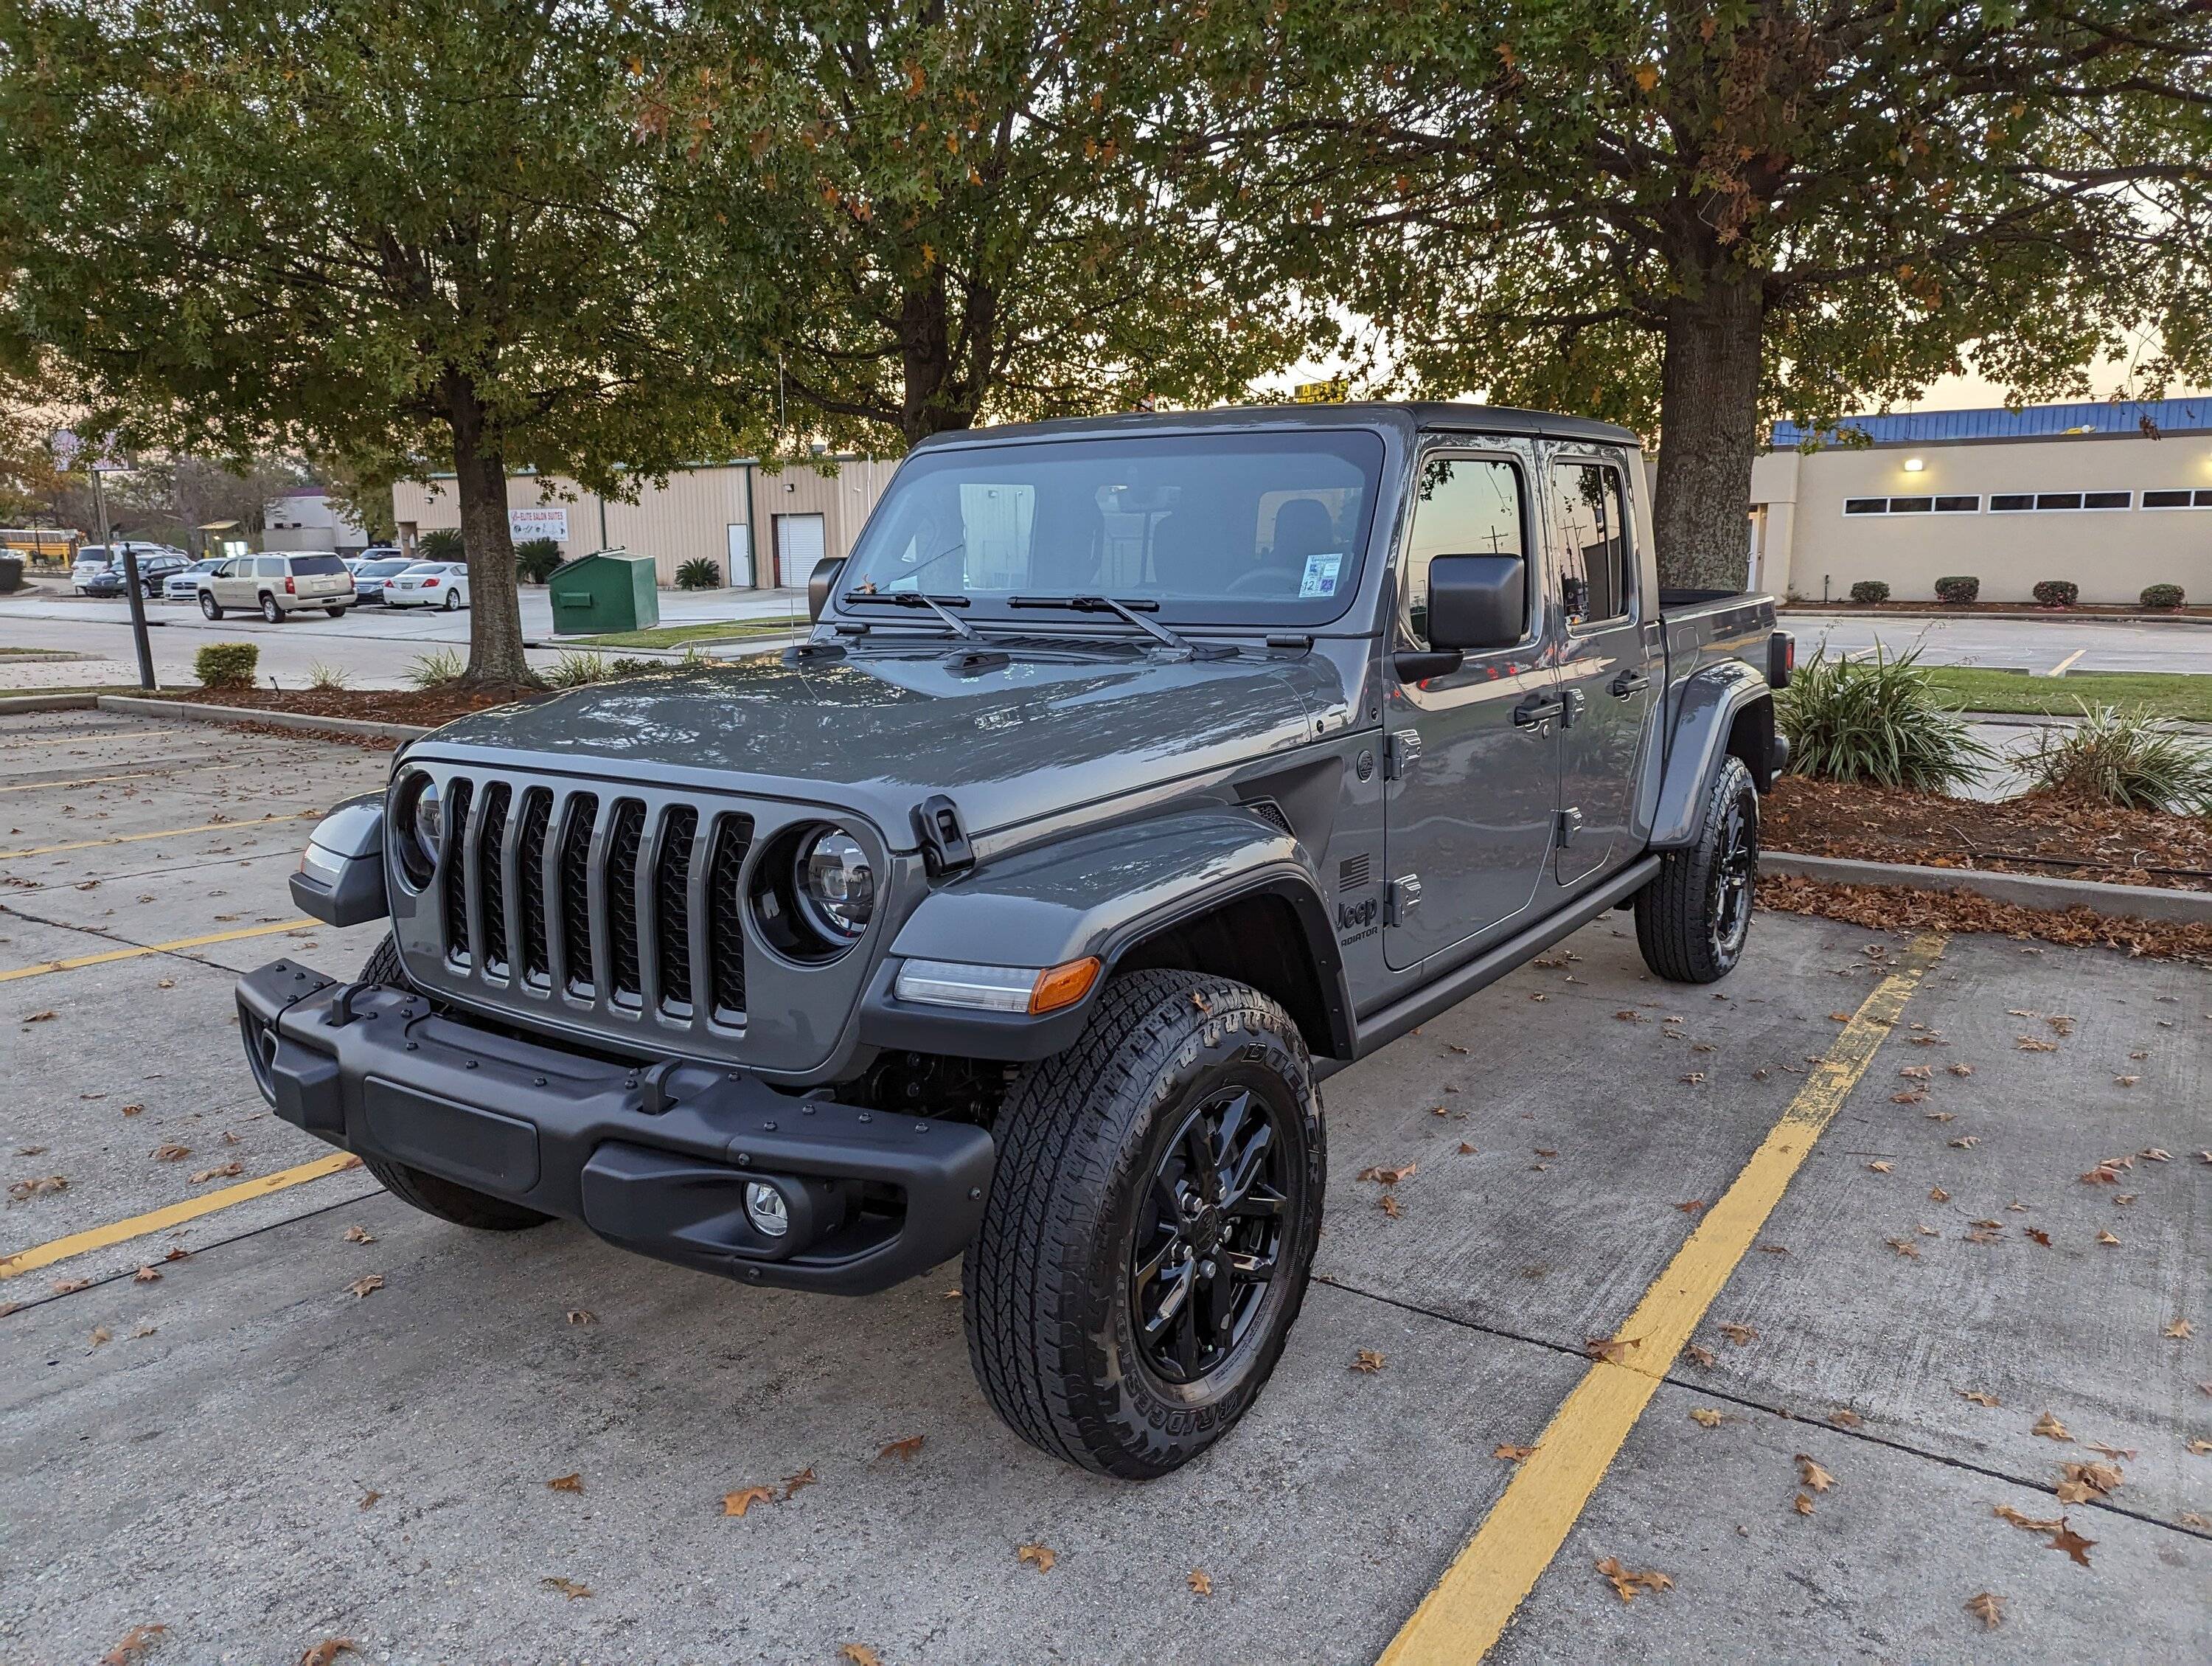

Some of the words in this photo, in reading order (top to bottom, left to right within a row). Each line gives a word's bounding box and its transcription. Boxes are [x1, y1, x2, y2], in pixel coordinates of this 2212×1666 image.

[533, 512, 546, 521] SALON
[549, 511, 563, 520] SUITES
[1303, 580, 1315, 591] 12
[1321, 579, 1334, 591] 23
[1335, 898, 1377, 932] Jeep
[1340, 926, 1377, 947] ADIATOR
